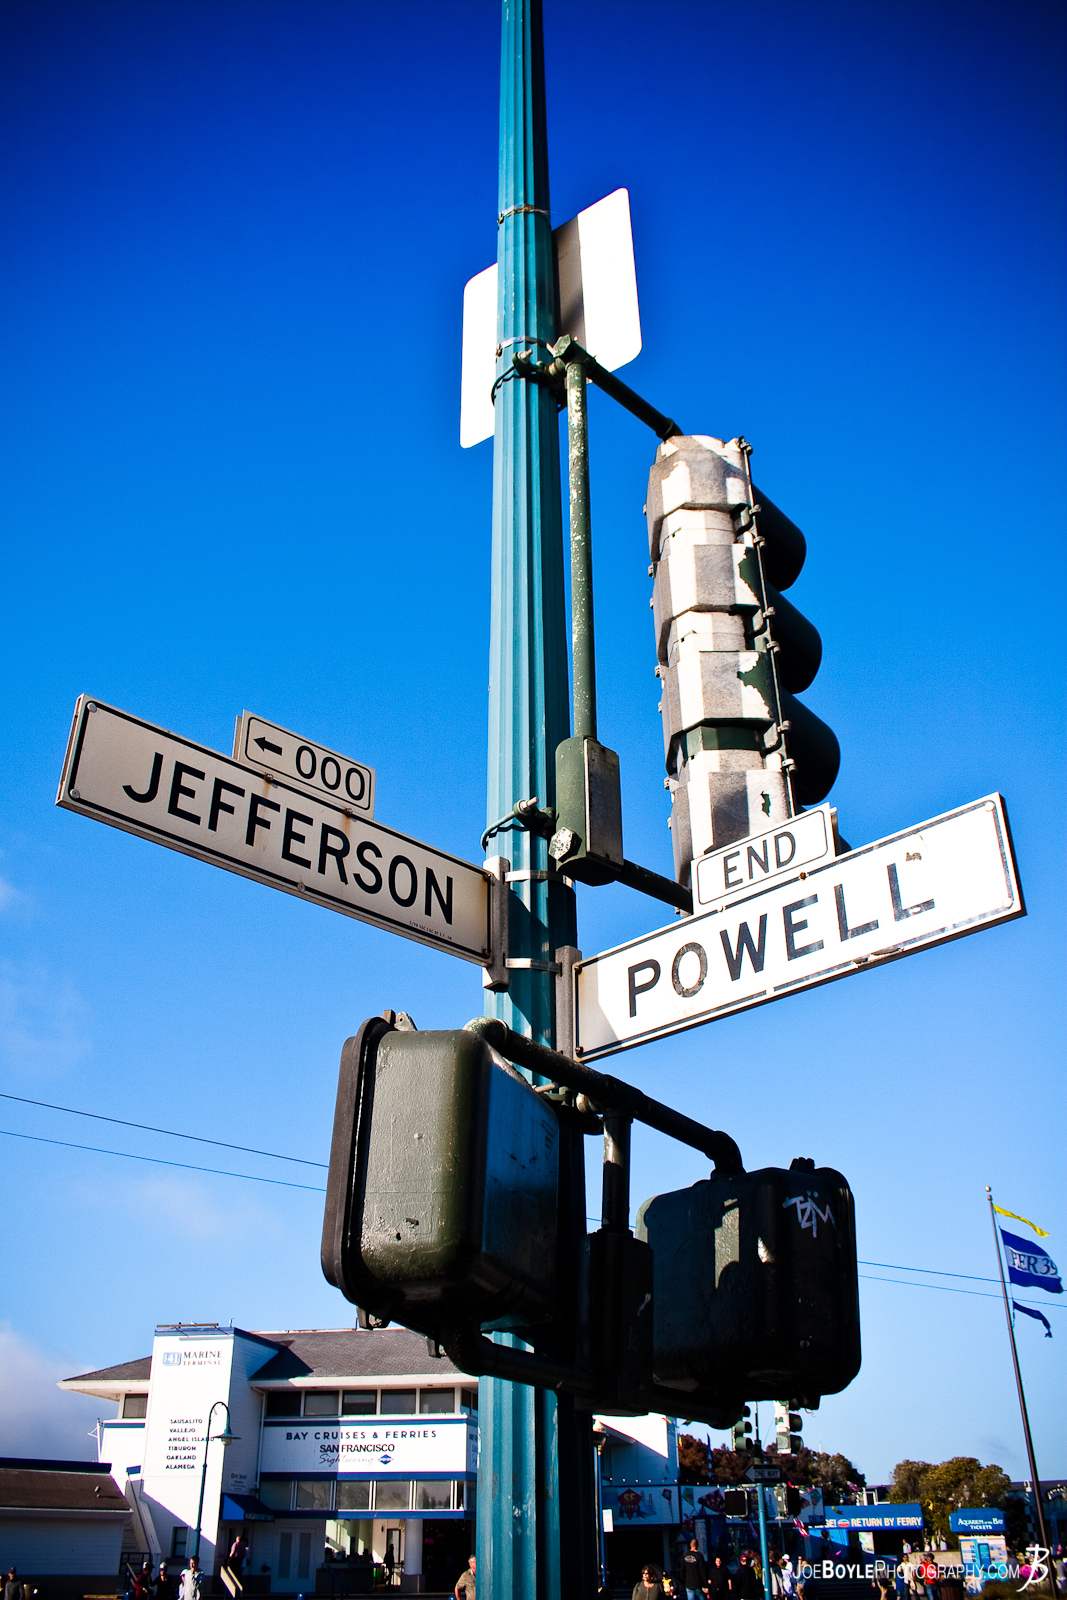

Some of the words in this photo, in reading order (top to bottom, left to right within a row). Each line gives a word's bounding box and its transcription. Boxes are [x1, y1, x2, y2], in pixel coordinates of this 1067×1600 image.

[122, 752, 454, 926] JEFFERSON
[723, 831, 796, 890] END
[627, 862, 935, 1018] POWELL
[183, 1350, 223, 1359] MARINE
[286, 1432, 308, 1440] BAY
[314, 1431, 366, 1440] CRUISES
[372, 1431, 379, 1439] &
[385, 1430, 437, 1439] FERRIES
[319, 1444, 340, 1453] SAN
[341, 1443, 395, 1453] FRANCISCO
[754, 1469, 766, 1478] ONE
[767, 1469, 779, 1478] WAY
[851, 1518, 883, 1528] RETURN
[884, 1518, 895, 1527] BY
[896, 1517, 922, 1526] FERRY
